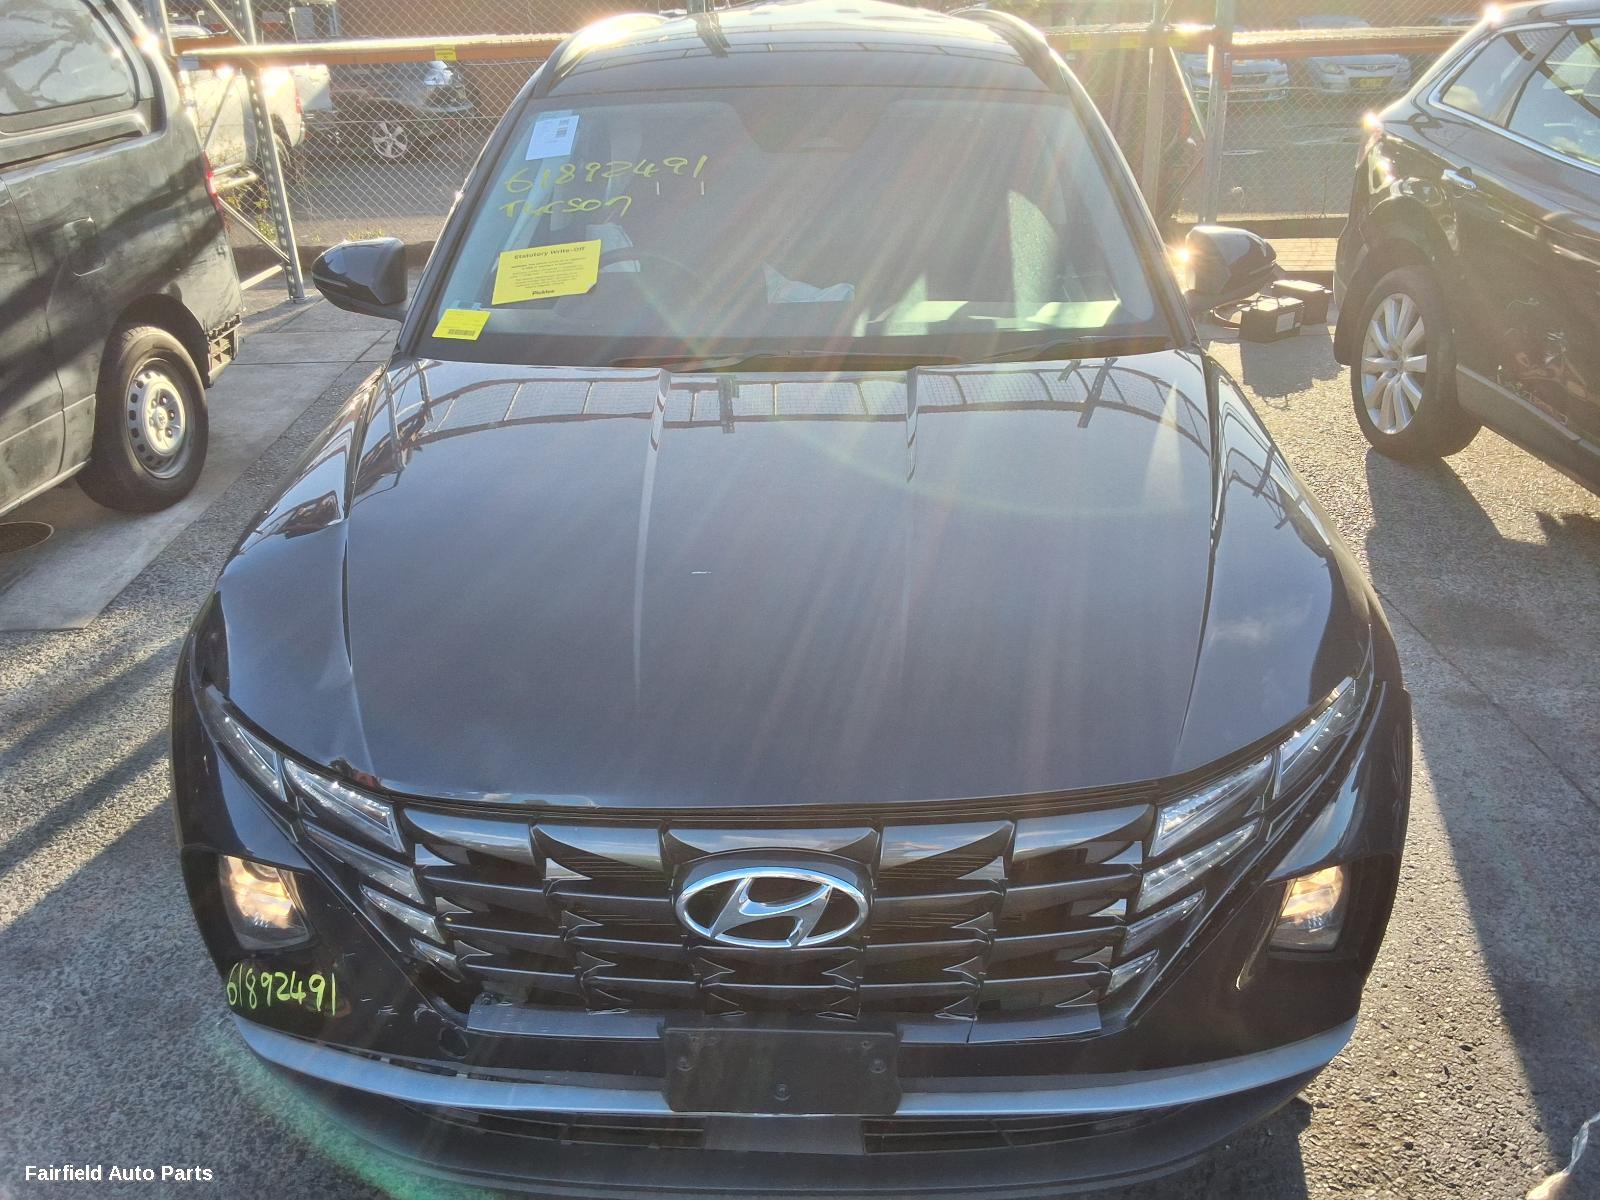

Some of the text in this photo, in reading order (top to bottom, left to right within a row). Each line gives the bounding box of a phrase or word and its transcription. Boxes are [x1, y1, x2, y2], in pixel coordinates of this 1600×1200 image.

[504, 154, 709, 193] 61892491
[514, 251, 549, 260] Statutory
[226, 962, 337, 1017] 61892491
